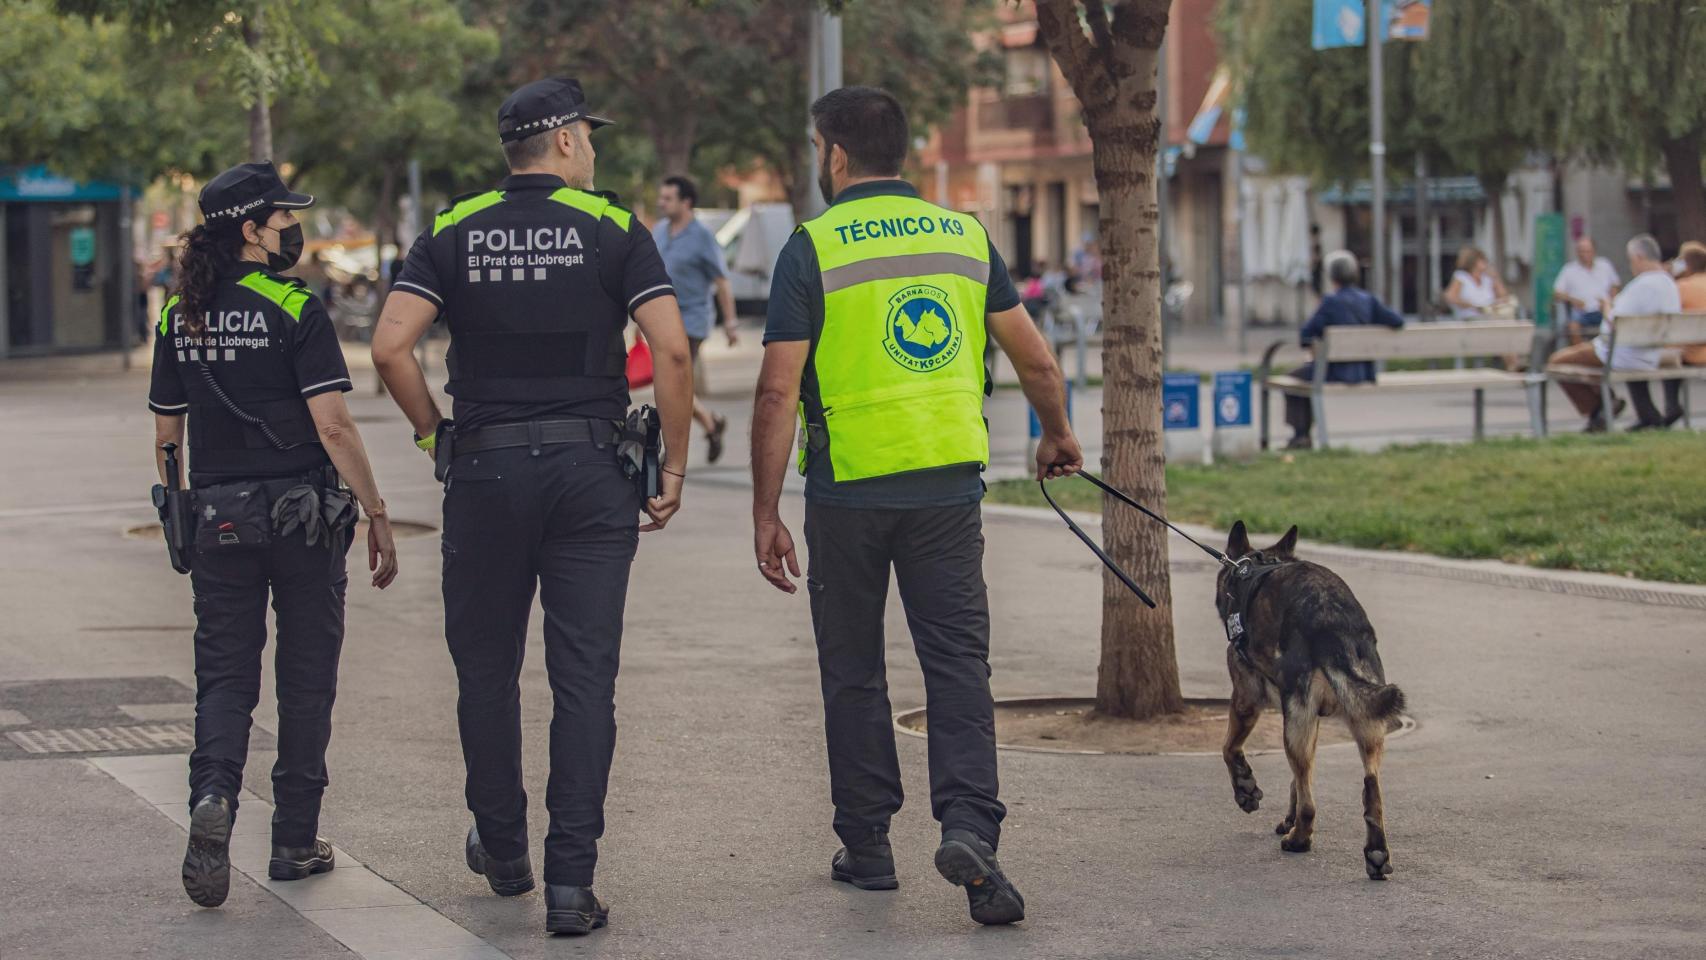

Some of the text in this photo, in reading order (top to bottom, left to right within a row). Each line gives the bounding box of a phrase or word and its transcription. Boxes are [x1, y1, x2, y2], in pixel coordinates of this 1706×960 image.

[560, 111, 579, 121] POLICIA
[243, 198, 265, 210] POLICIA
[834, 216, 964, 245] TÉCNICO K9
[468, 227, 583, 252] POLICIA
[468, 253, 584, 267] El Prat de Llobregat
[895, 288, 942, 304] BARNAGOS
[174, 311, 269, 334] PLICIA
[175, 337, 184, 348] El
[204, 335, 217, 346] de
[219, 335, 269, 350] Llobregat
